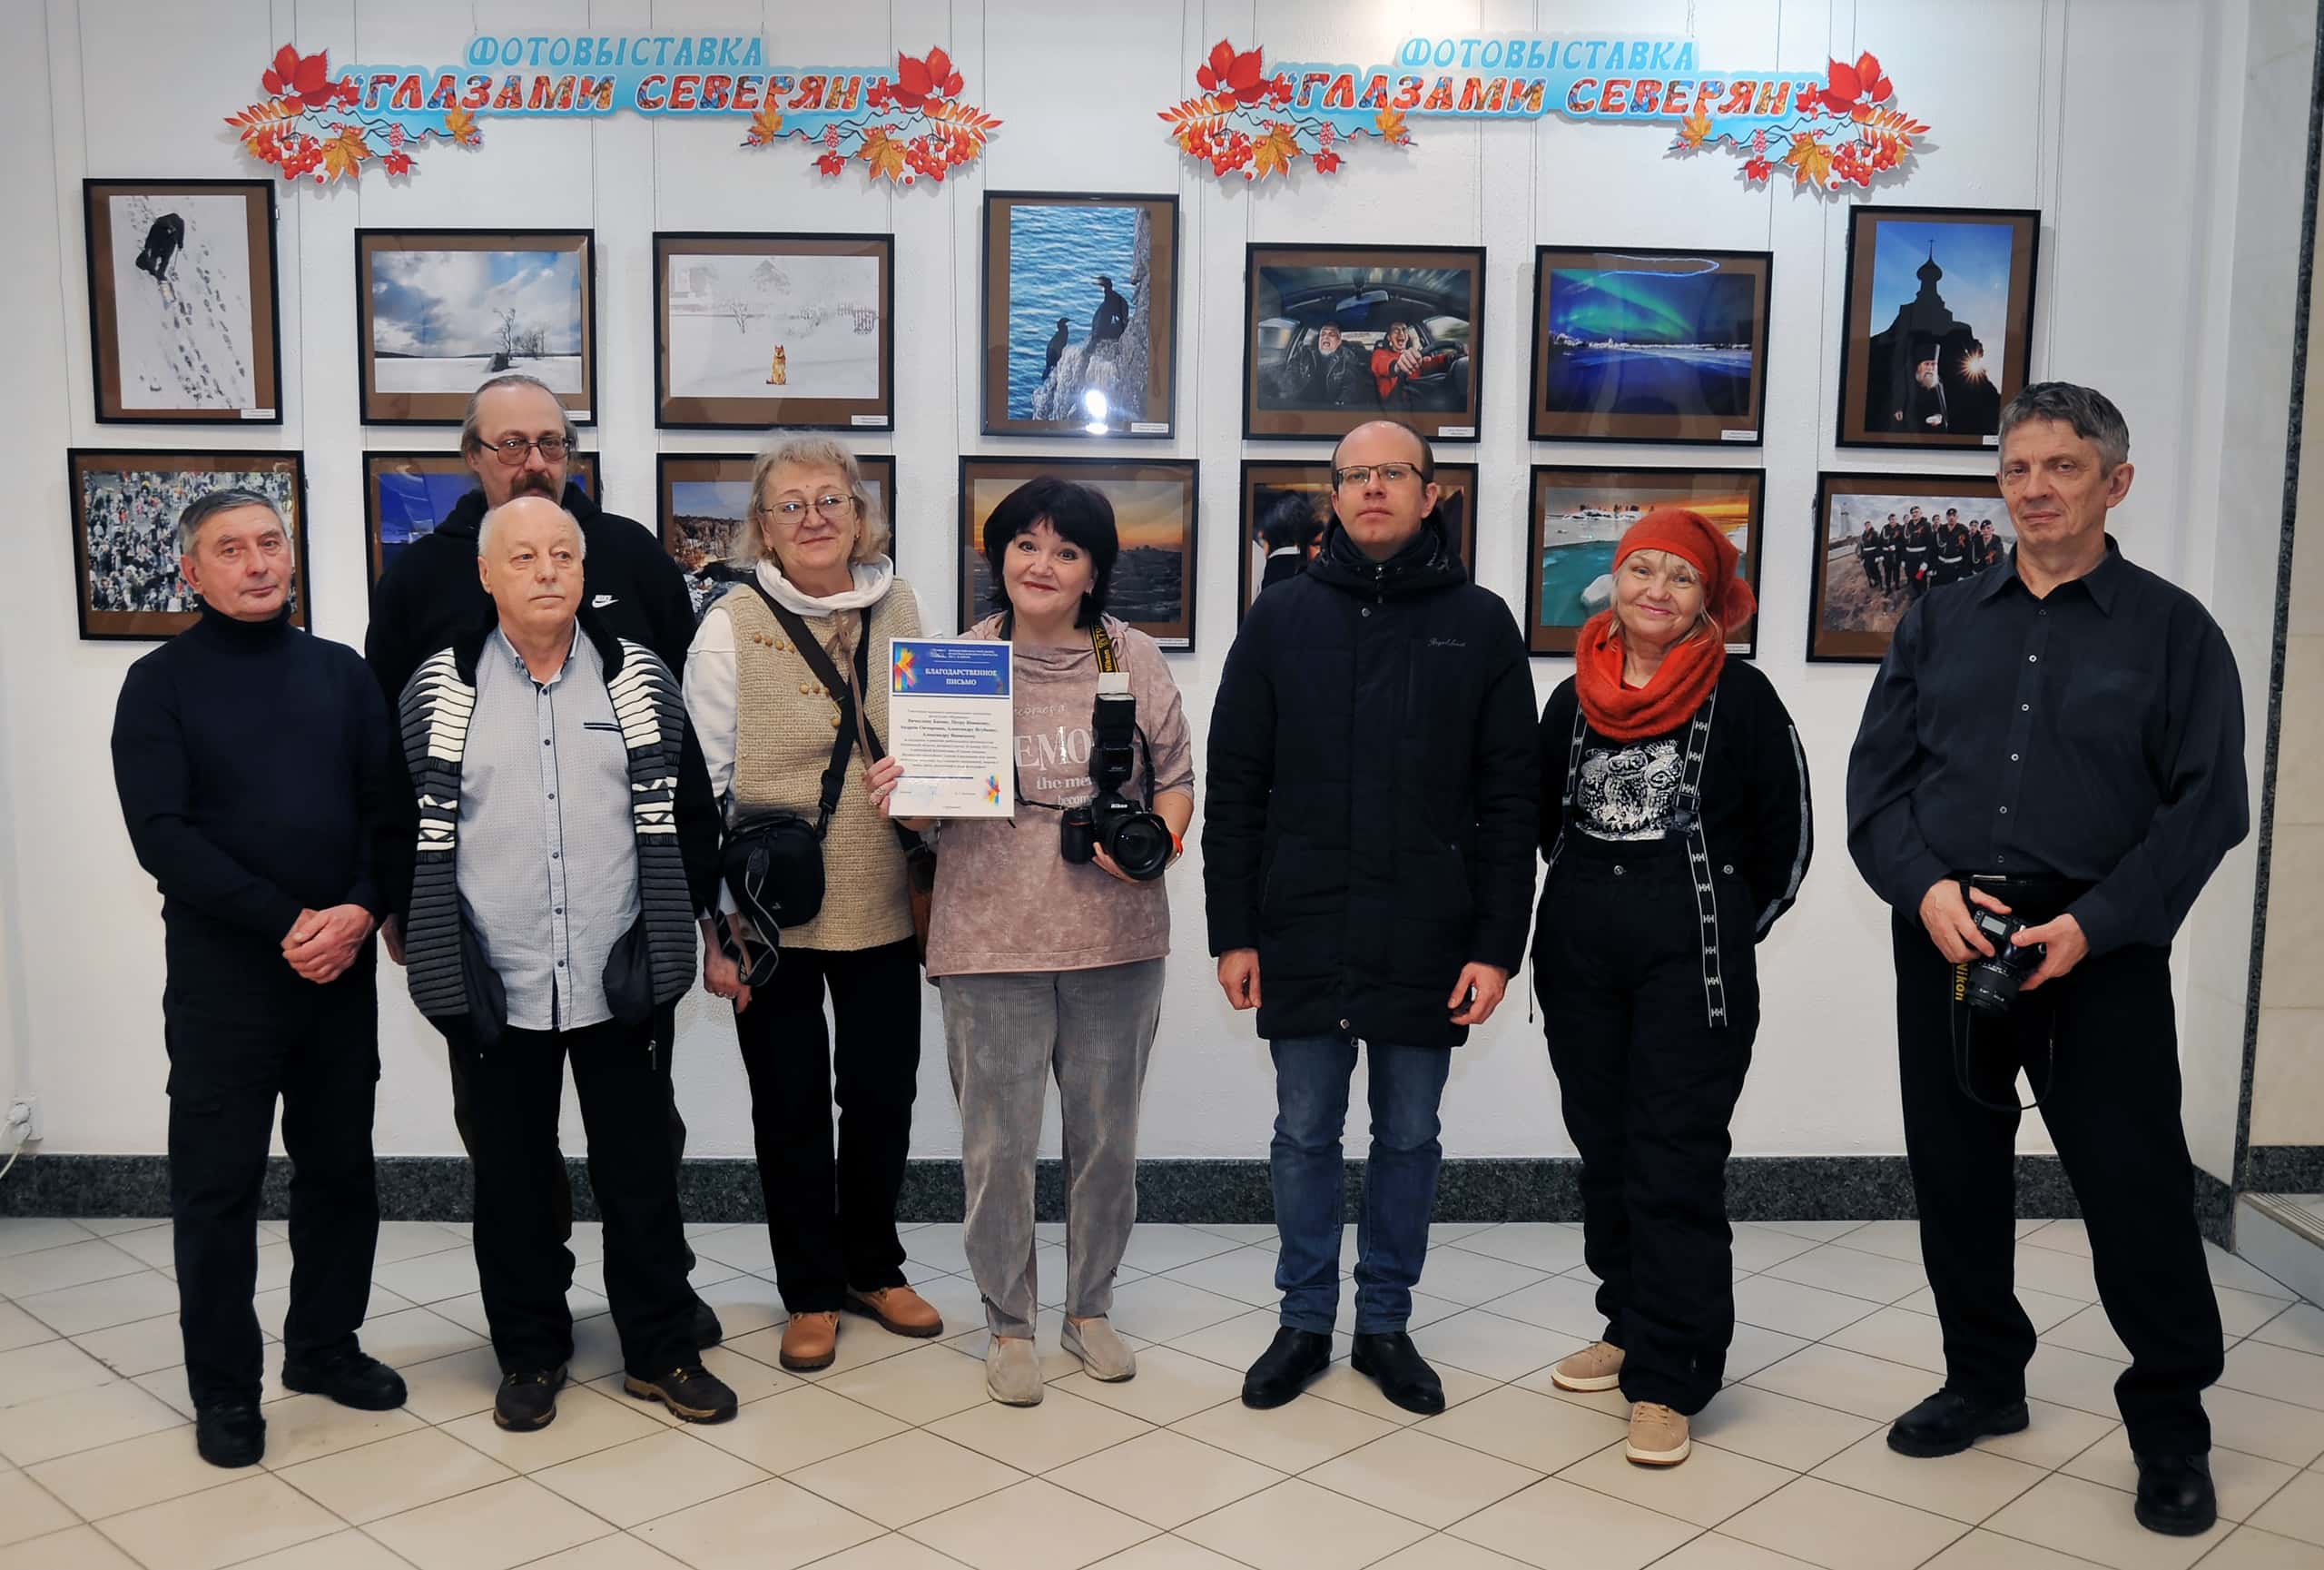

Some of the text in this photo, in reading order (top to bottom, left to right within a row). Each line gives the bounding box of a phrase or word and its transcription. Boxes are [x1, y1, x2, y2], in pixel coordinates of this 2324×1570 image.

[468, 36, 763, 67] ФОТОВЫСТАВКА
[1400, 37, 1695, 71] ФОТОВЫСТАВКА
[925, 667, 998, 676] БЛАГОДАРСТВЕННОЕ
[946, 677, 977, 686] ПИСЬМО
[1014, 726, 1092, 772] EMO
[1037, 775, 1062, 790] the
[1955, 962, 1969, 1001] Nikon
